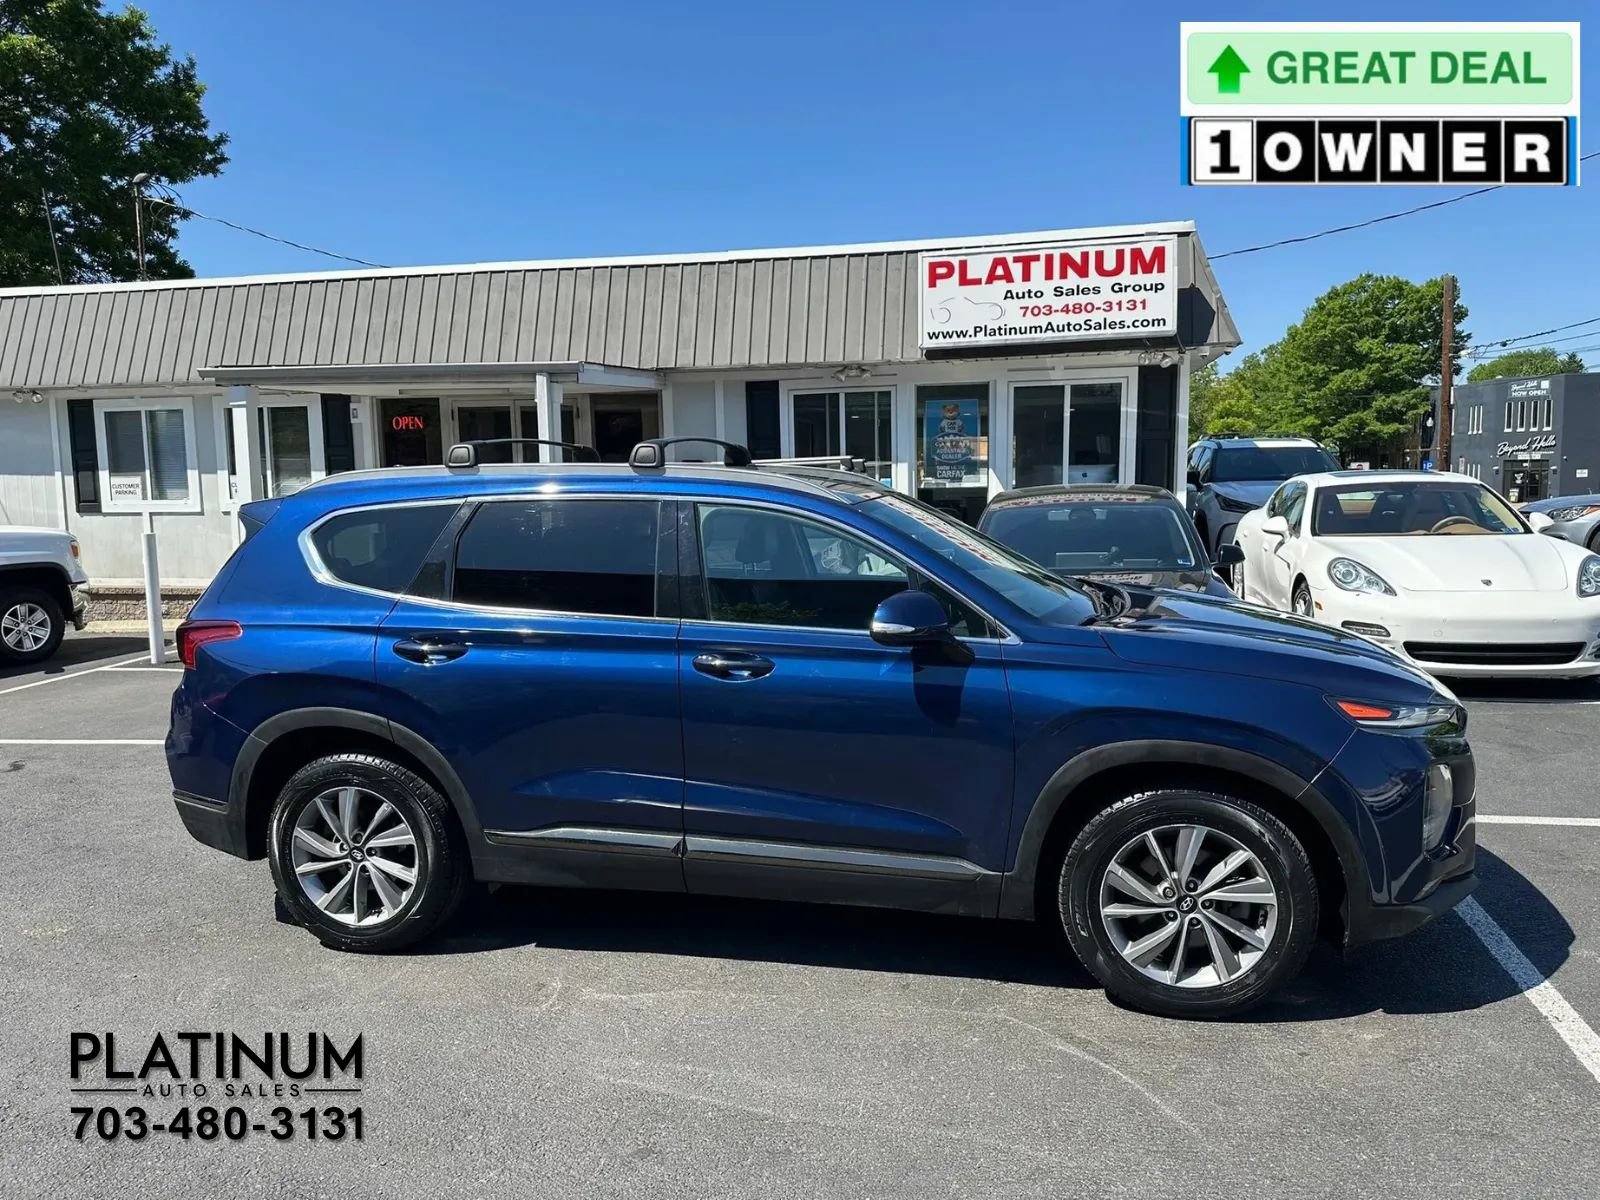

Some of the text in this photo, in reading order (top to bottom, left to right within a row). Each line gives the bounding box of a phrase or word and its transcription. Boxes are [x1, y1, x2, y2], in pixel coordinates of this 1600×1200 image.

[928, 246, 1166, 288] PLATINUM
[1003, 281, 1165, 301] Auto Sales Group
[1019, 299, 1147, 318] 703-480-3131
[927, 316, 1167, 341] www.PlatinumAutoSales.com
[392, 416, 423, 430] OPEN
[1497, 434, 1556, 456] Beyond Hello
[936, 470, 966, 478] CARFAX
